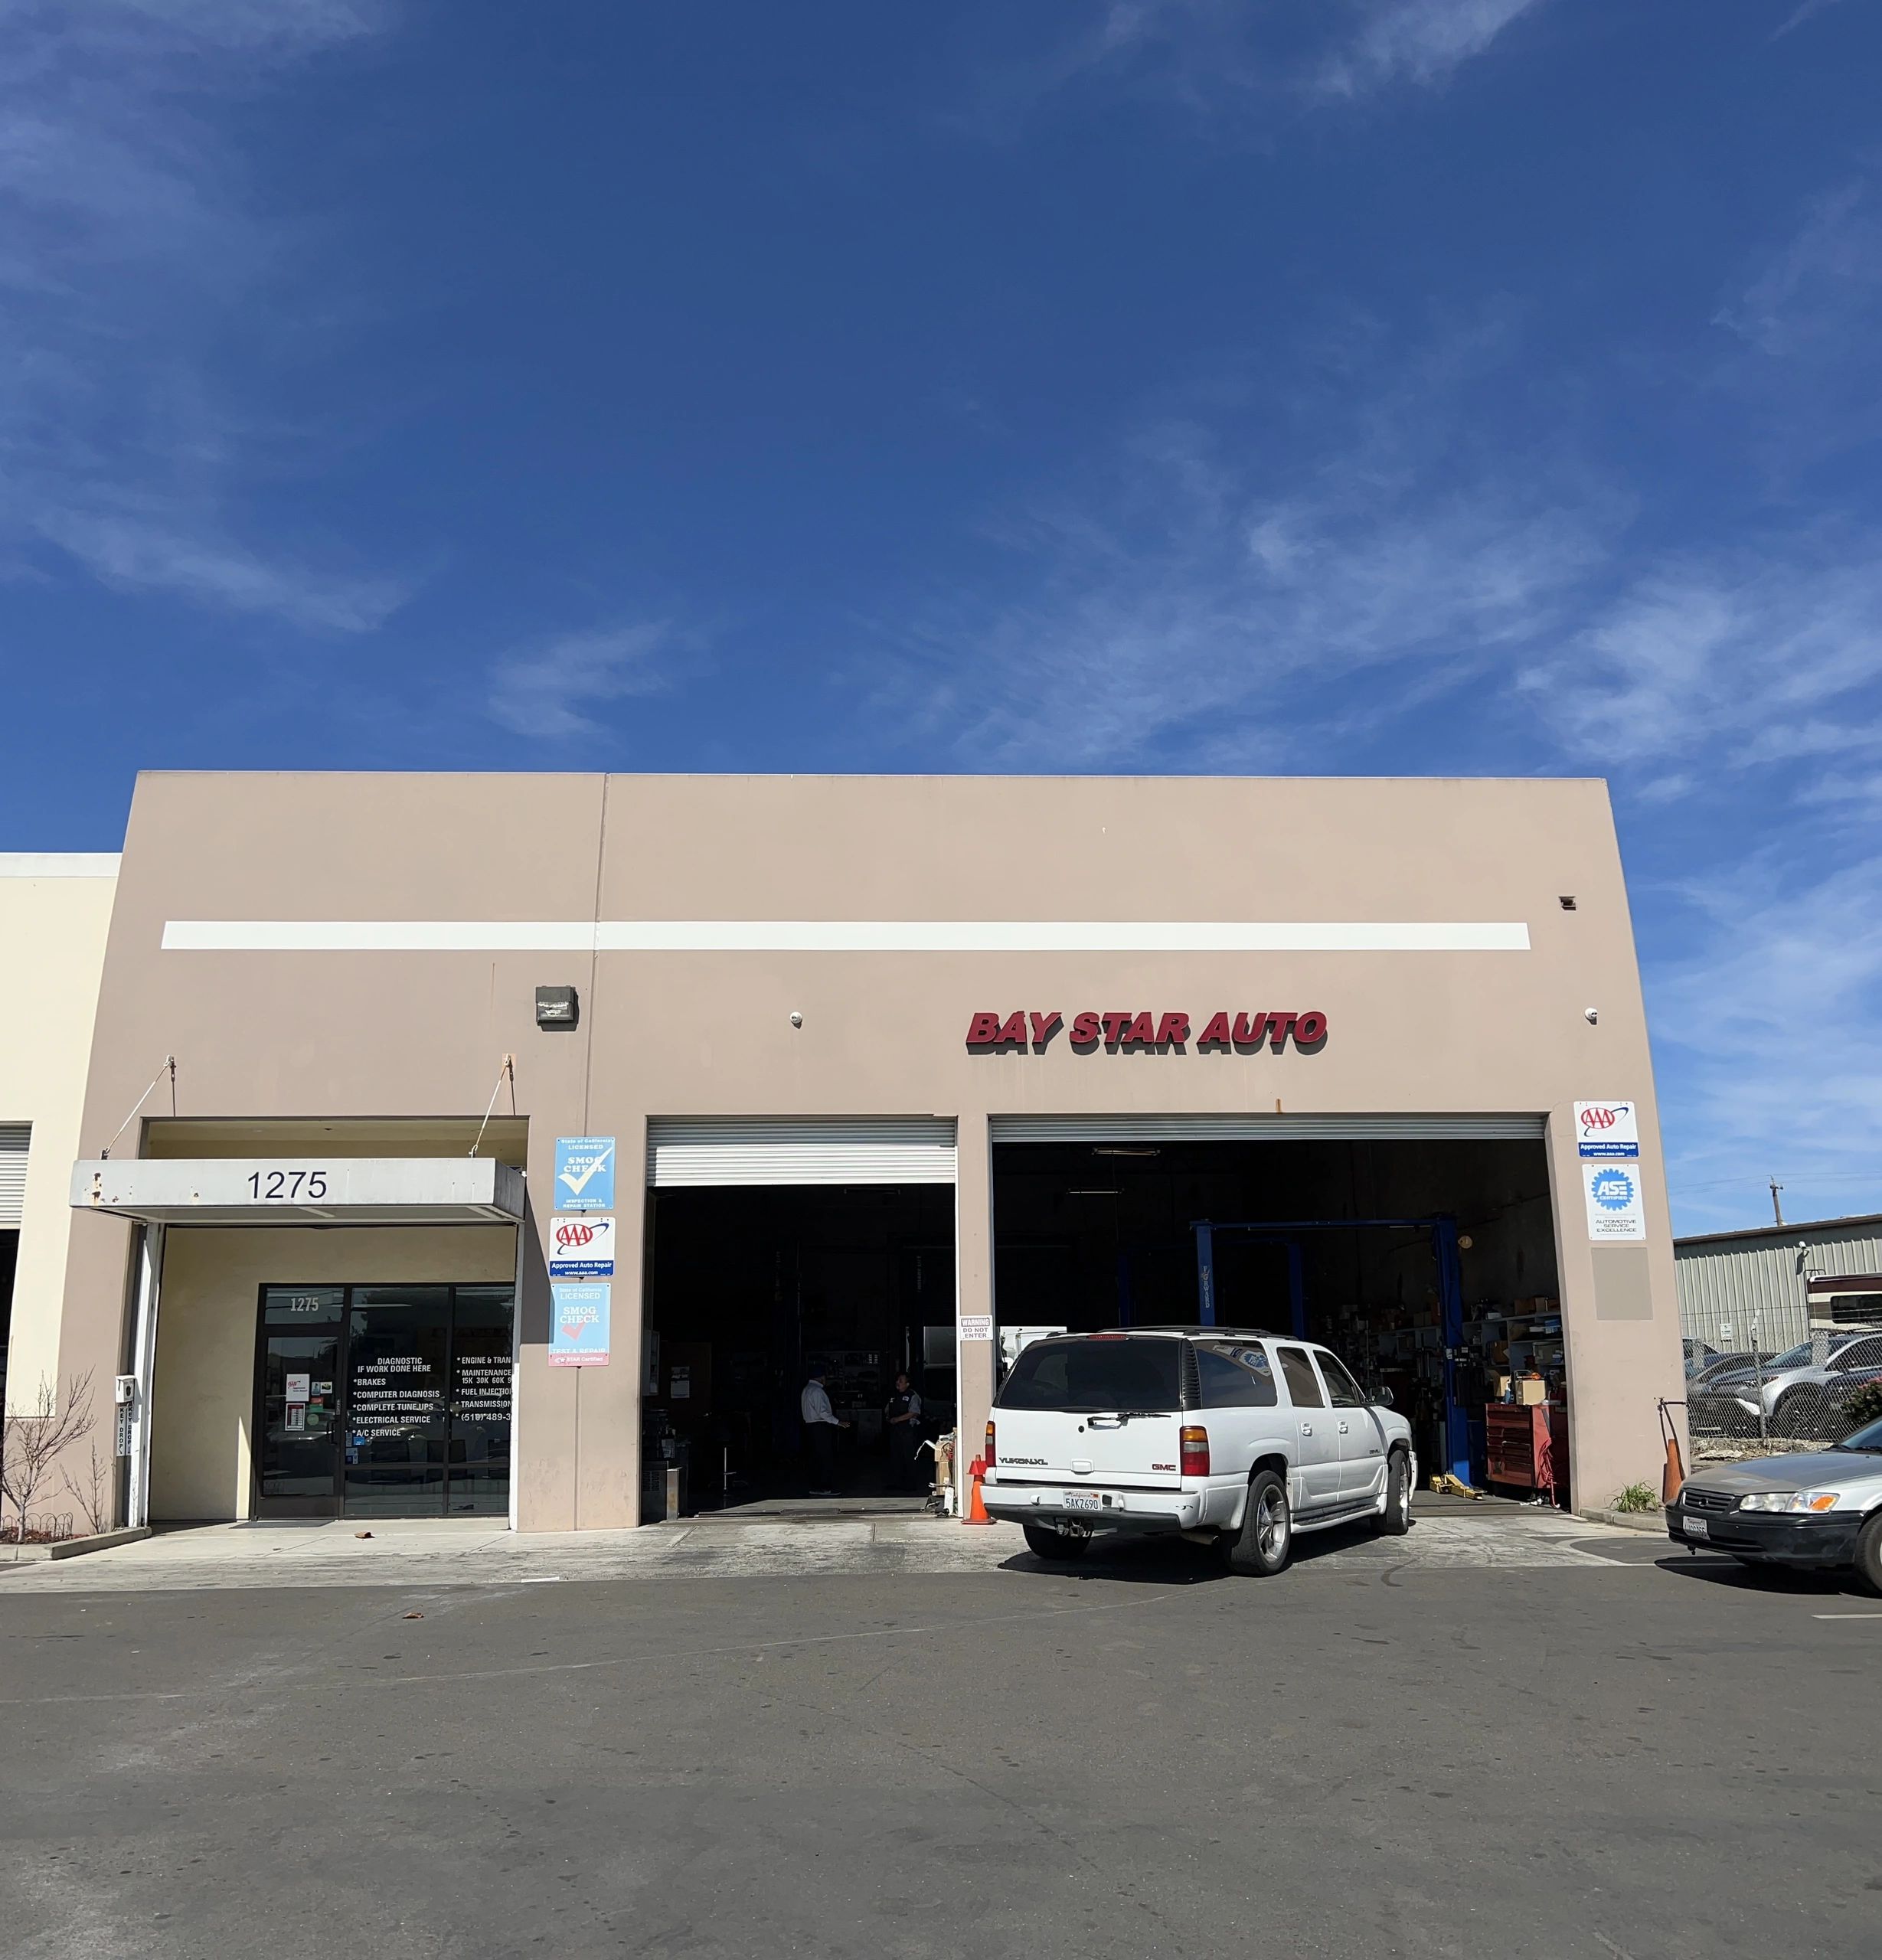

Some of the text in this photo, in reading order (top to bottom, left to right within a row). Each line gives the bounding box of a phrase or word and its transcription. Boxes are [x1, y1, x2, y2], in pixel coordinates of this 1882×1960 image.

[966, 1011, 1327, 1046] BAY STAR AUTO
[1585, 1109, 1614, 1129] AAA
[248, 1171, 327, 1199] 1275
[1597, 1181, 1627, 1195] ASE
[559, 1224, 590, 1246] AAA
[291, 1298, 319, 1312] 1275
[1066, 1498, 1098, 1509] 5AKZ690
